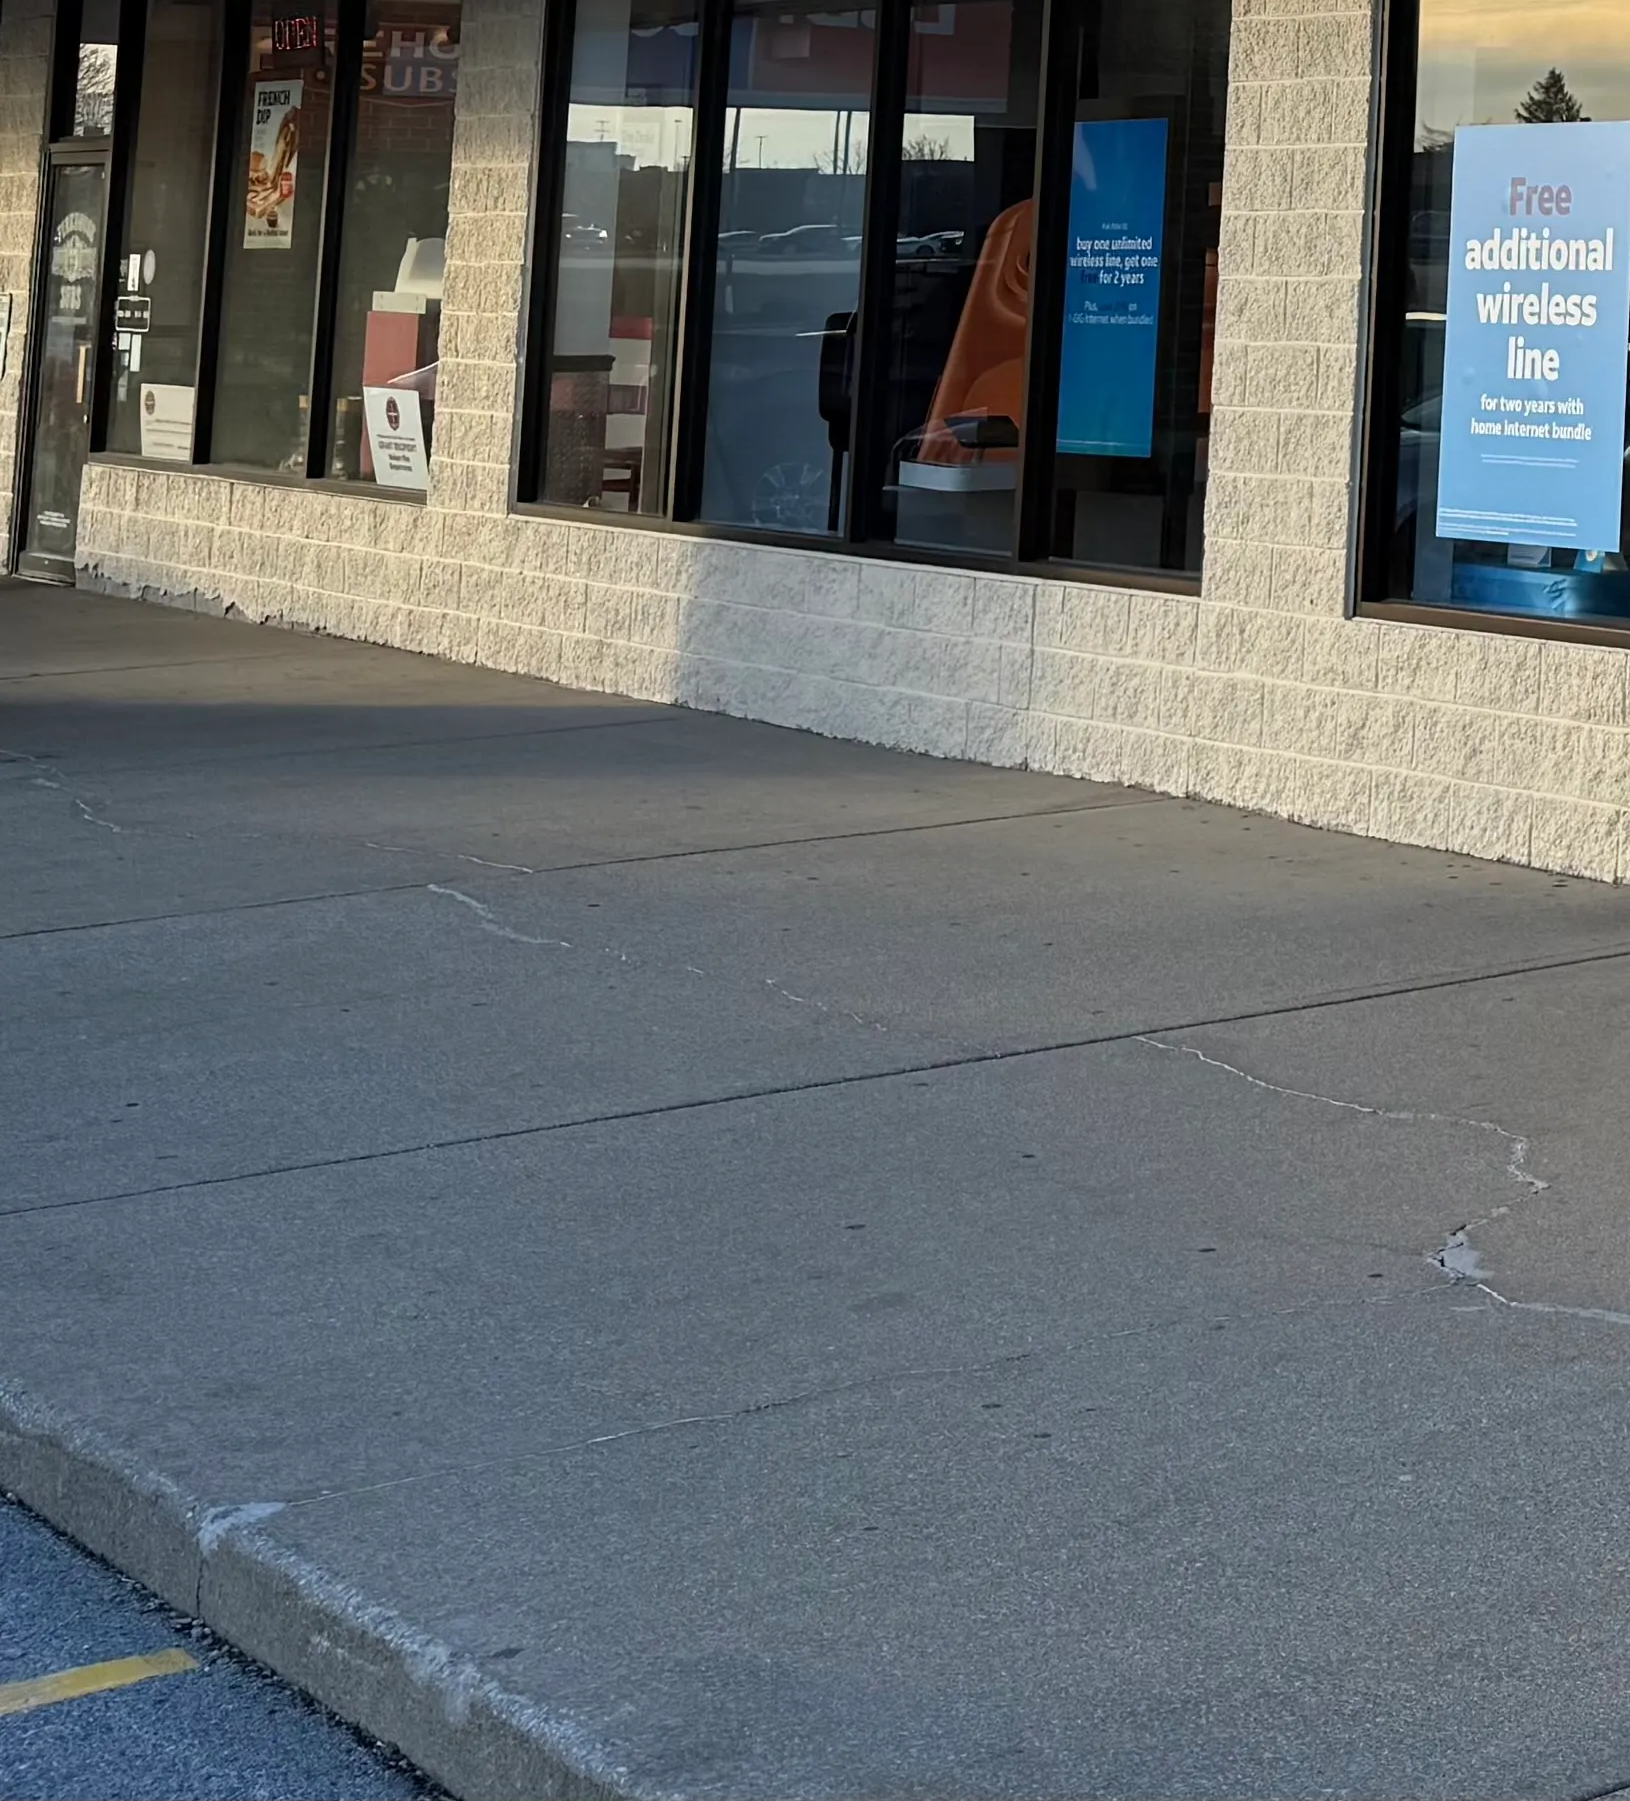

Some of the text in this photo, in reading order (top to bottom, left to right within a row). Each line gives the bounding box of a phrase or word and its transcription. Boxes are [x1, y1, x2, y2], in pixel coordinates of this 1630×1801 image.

[274, 16, 318, 50] OPEN
[258, 90, 291, 108] FRENCH
[1509, 176, 1573, 216] Free
[1076, 236, 1153, 256] buy one unlimited
[1464, 227, 1614, 271] additional
[1070, 253, 1104, 267] wireless
[1124, 255, 1140, 270] get
[1140, 256, 1159, 268] one
[1099, 270, 1113, 284] for
[1113, 270, 1120, 285] 2
[1120, 272, 1145, 287] years
[1476, 282, 1598, 326] wireless
[1506, 336, 1560, 381] line
[1480, 393, 1584, 416] for two years with
[1471, 418, 1501, 435] home
[1551, 421, 1592, 441] bundle
